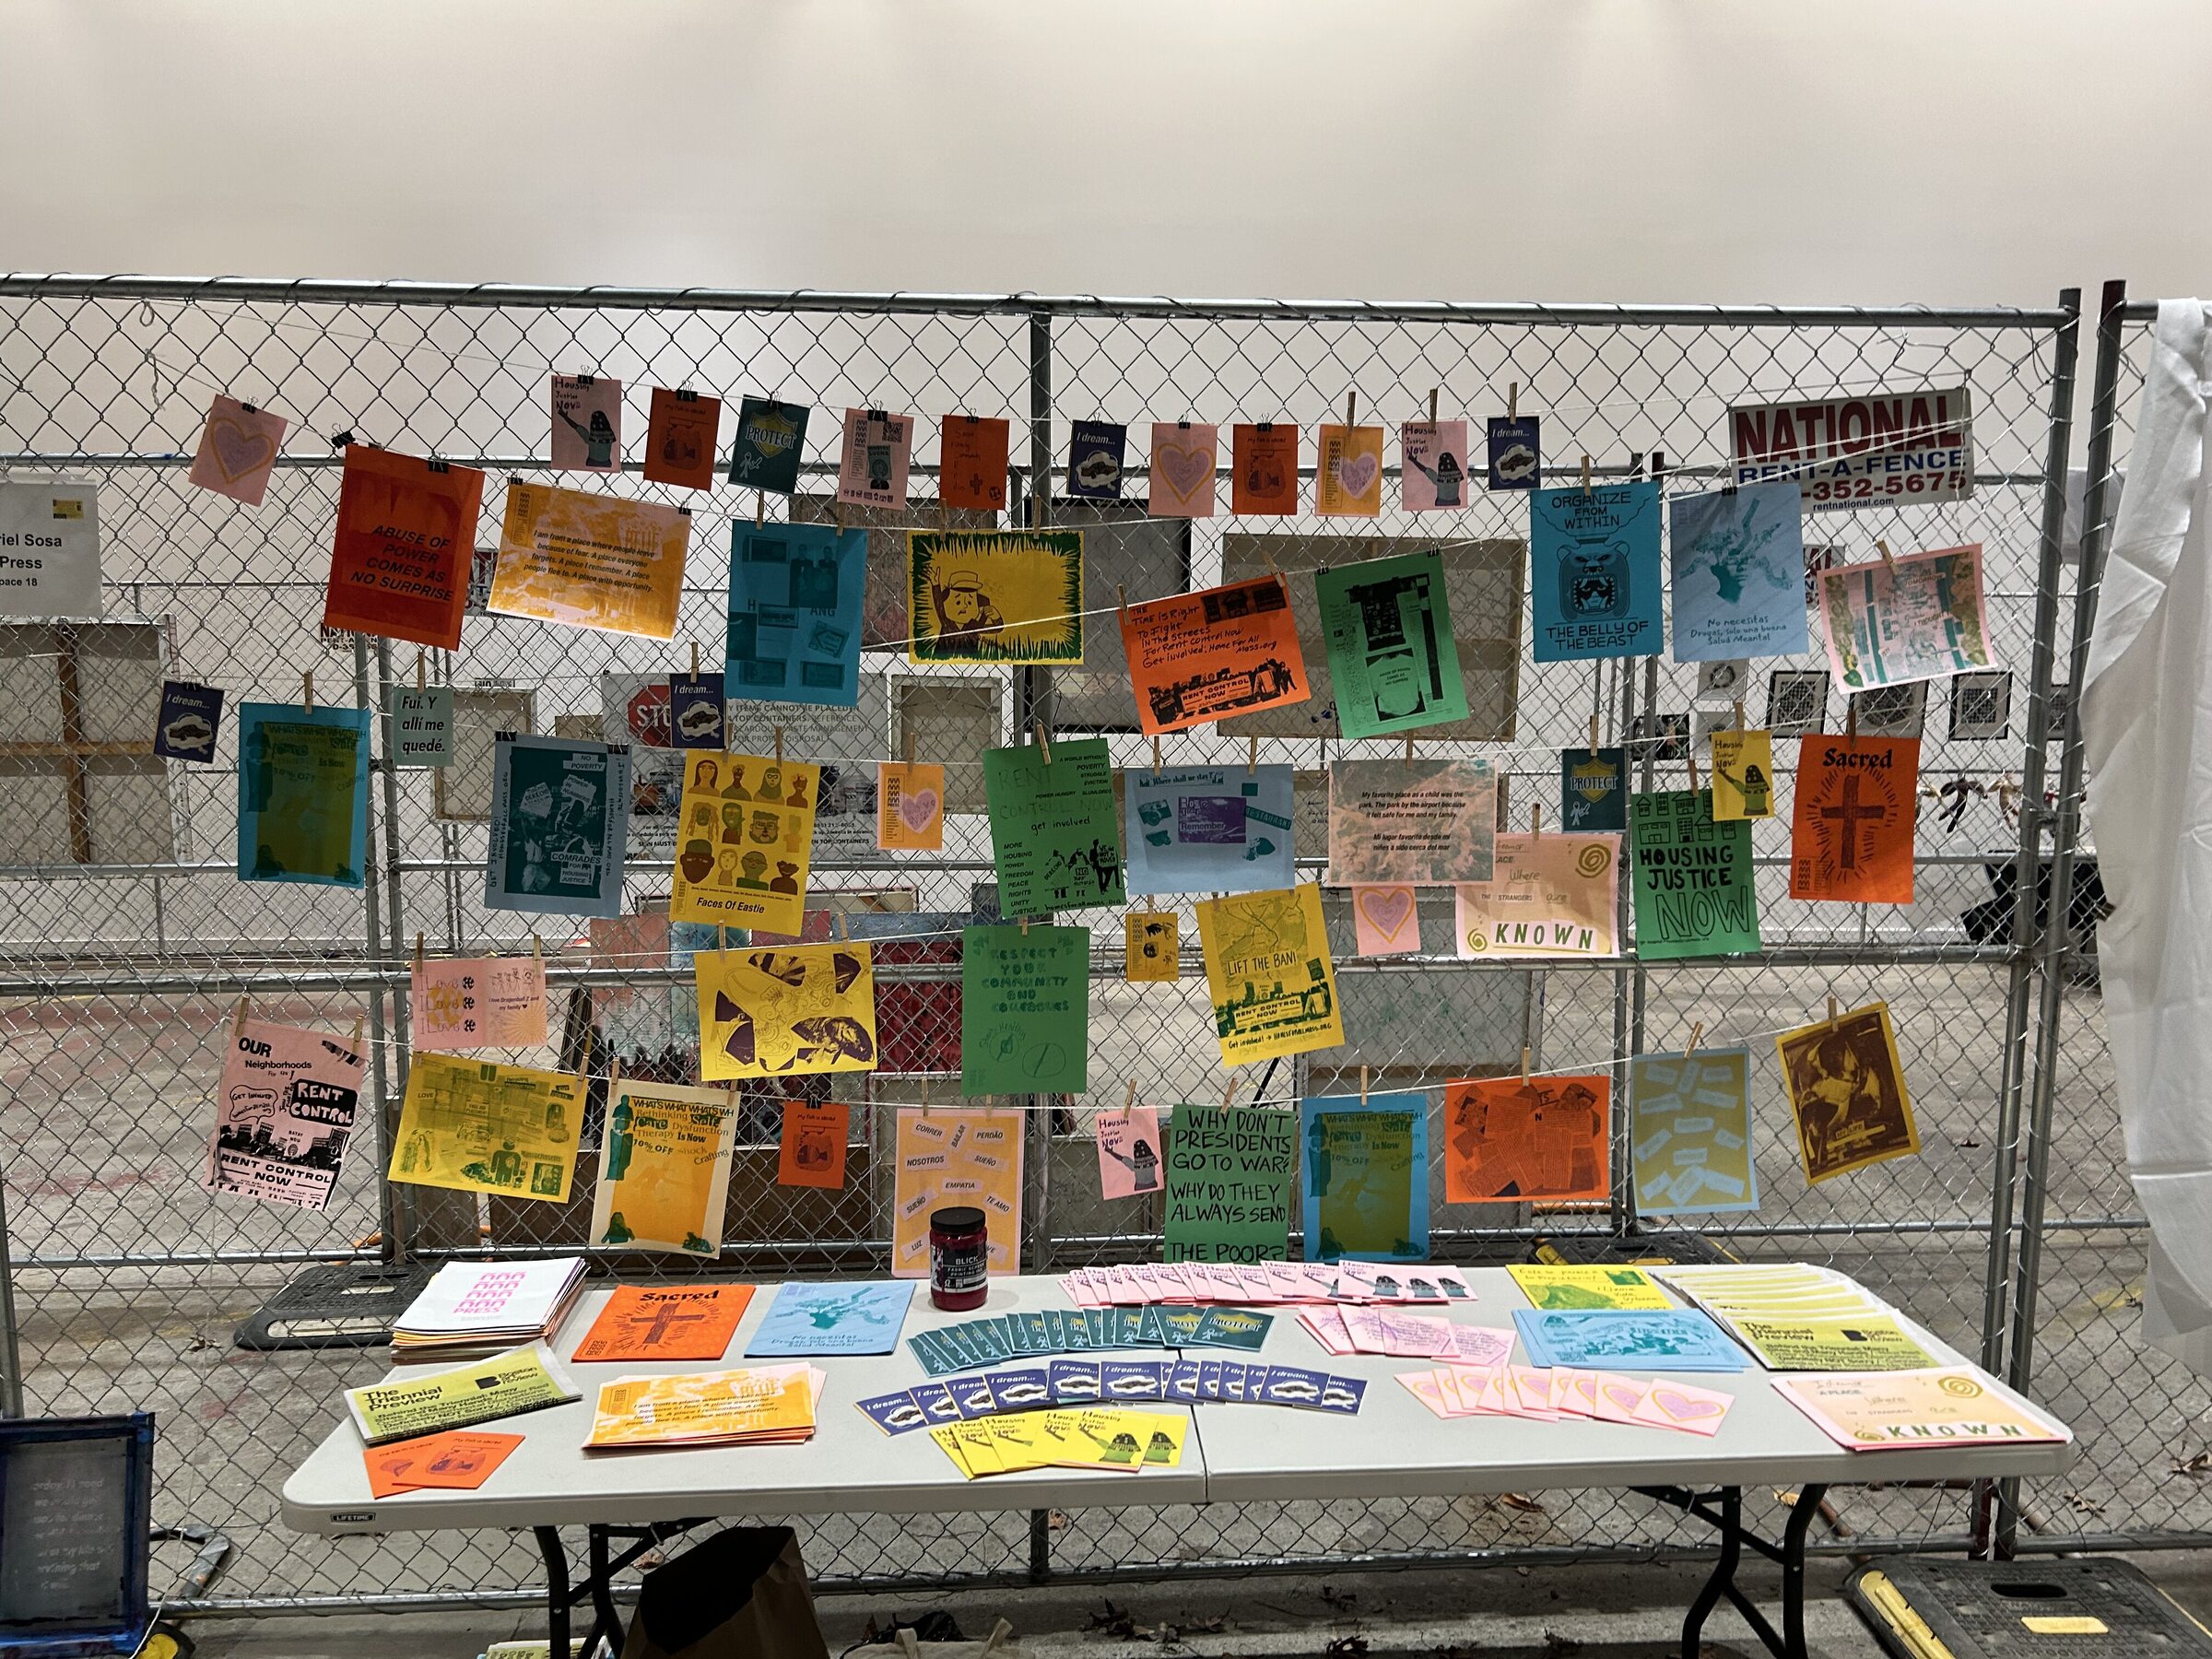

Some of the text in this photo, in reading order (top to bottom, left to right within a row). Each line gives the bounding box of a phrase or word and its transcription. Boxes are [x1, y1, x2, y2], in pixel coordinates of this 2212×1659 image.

[745, 425, 797, 450] PROTECT
[1735, 395, 1962, 465] NATIONAL
[1739, 450, 1966, 485] RENT-A-FENCE
[1802, 470, 1967, 501] -352-5675
[1552, 491, 1631, 508] ORGANIZE
[1813, 497, 1894, 512] rentnational.com
[1575, 506, 1607, 516] FROM
[1564, 514, 1619, 530] WITHIN
[0, 534, 63, 547] iel Sosa
[371, 524, 451, 549] ABUSE OF
[537, 531, 548, 540] am
[549, 531, 566, 542] from
[571, 536, 591, 548] place
[591, 540, 613, 551] where
[613, 545, 636, 557] people
[637, 547, 655, 558] leave
[0, 556, 42, 569] Press
[382, 543, 441, 565] POWER
[366, 557, 446, 583] COMES AS
[26, 578, 38, 586] 18
[351, 571, 454, 602] NO SURPRISE
[1132, 606, 1148, 616] THE
[1546, 620, 1649, 639] THE BELLY OF
[1707, 615, 1769, 629] No necesitas
[1760, 624, 1787, 632] buena
[1555, 633, 1636, 651] THE BEAST
[1708, 635, 1731, 645] Salud
[1182, 677, 1250, 700] RENT CONTROL
[1204, 690, 1227, 701] NOW
[401, 696, 439, 710] Fui. Y
[402, 715, 444, 731] allí me
[637, 704, 671, 727] STO
[402, 737, 446, 755] quedé.
[1822, 747, 1893, 769] Sacred
[1571, 774, 1618, 790] PROTECT
[1361, 791, 1371, 799] My
[1371, 791, 1394, 799] favorite
[1394, 791, 1411, 799] place
[1031, 816, 1091, 836] get involved
[552, 853, 602, 865] COMRADES
[1639, 844, 1734, 869] HOUSING
[1647, 866, 1733, 892] JUSTICE
[696, 897, 766, 914] Faces Of Eastie
[1654, 885, 1750, 940] NOW
[1227, 951, 1297, 976] LIFT THE BAN!
[1235, 998, 1301, 1018] RENT CONTROL
[1256, 1008, 1277, 1018] NOW
[239, 1037, 272, 1058] OUR
[245, 1060, 312, 1069] Neighborhoods
[298, 1082, 344, 1100] RENT
[290, 1101, 353, 1124] CONTROL
[636, 1109, 688, 1120] Rethinking
[636, 1116, 668, 1130] Care
[672, 1122, 729, 1136] Dysfunction
[915, 1124, 943, 1138] CORRER
[1188, 1110, 1291, 1134] WHY DON'T
[636, 1129, 706, 1143] Therapy Is Now
[950, 1124, 966, 1148] BAILAR
[976, 1130, 1004, 1140] PERDÃO
[1175, 1129, 1290, 1155] PRESIDENTS
[633, 1139, 674, 1156] 10% OFF
[693, 1148, 730, 1166] Crafting
[906, 1155, 945, 1167] NOSOTROS
[974, 1155, 996, 1167] SUEÑO
[1172, 1153, 1289, 1174] GO TO WAR?
[220, 1154, 331, 1184] RENT CONTROL
[254, 1171, 292, 1187] NOW
[1171, 1181, 1281, 1203] WHY DO THEY
[906, 1196, 926, 1214] SUEÑO
[986, 1195, 1010, 1213] TE AMO
[1171, 1203, 1286, 1225] ALWAYS SEND
[912, 1240, 924, 1252] LUZ
[1171, 1242, 1285, 1263] THE POOR?
[956, 1256, 979, 1265] BLICK
[639, 1289, 720, 1301] Sacred
[363, 1388, 399, 1398] The
[368, 1386, 442, 1406] Triennial
[369, 1393, 441, 1412] Preview
